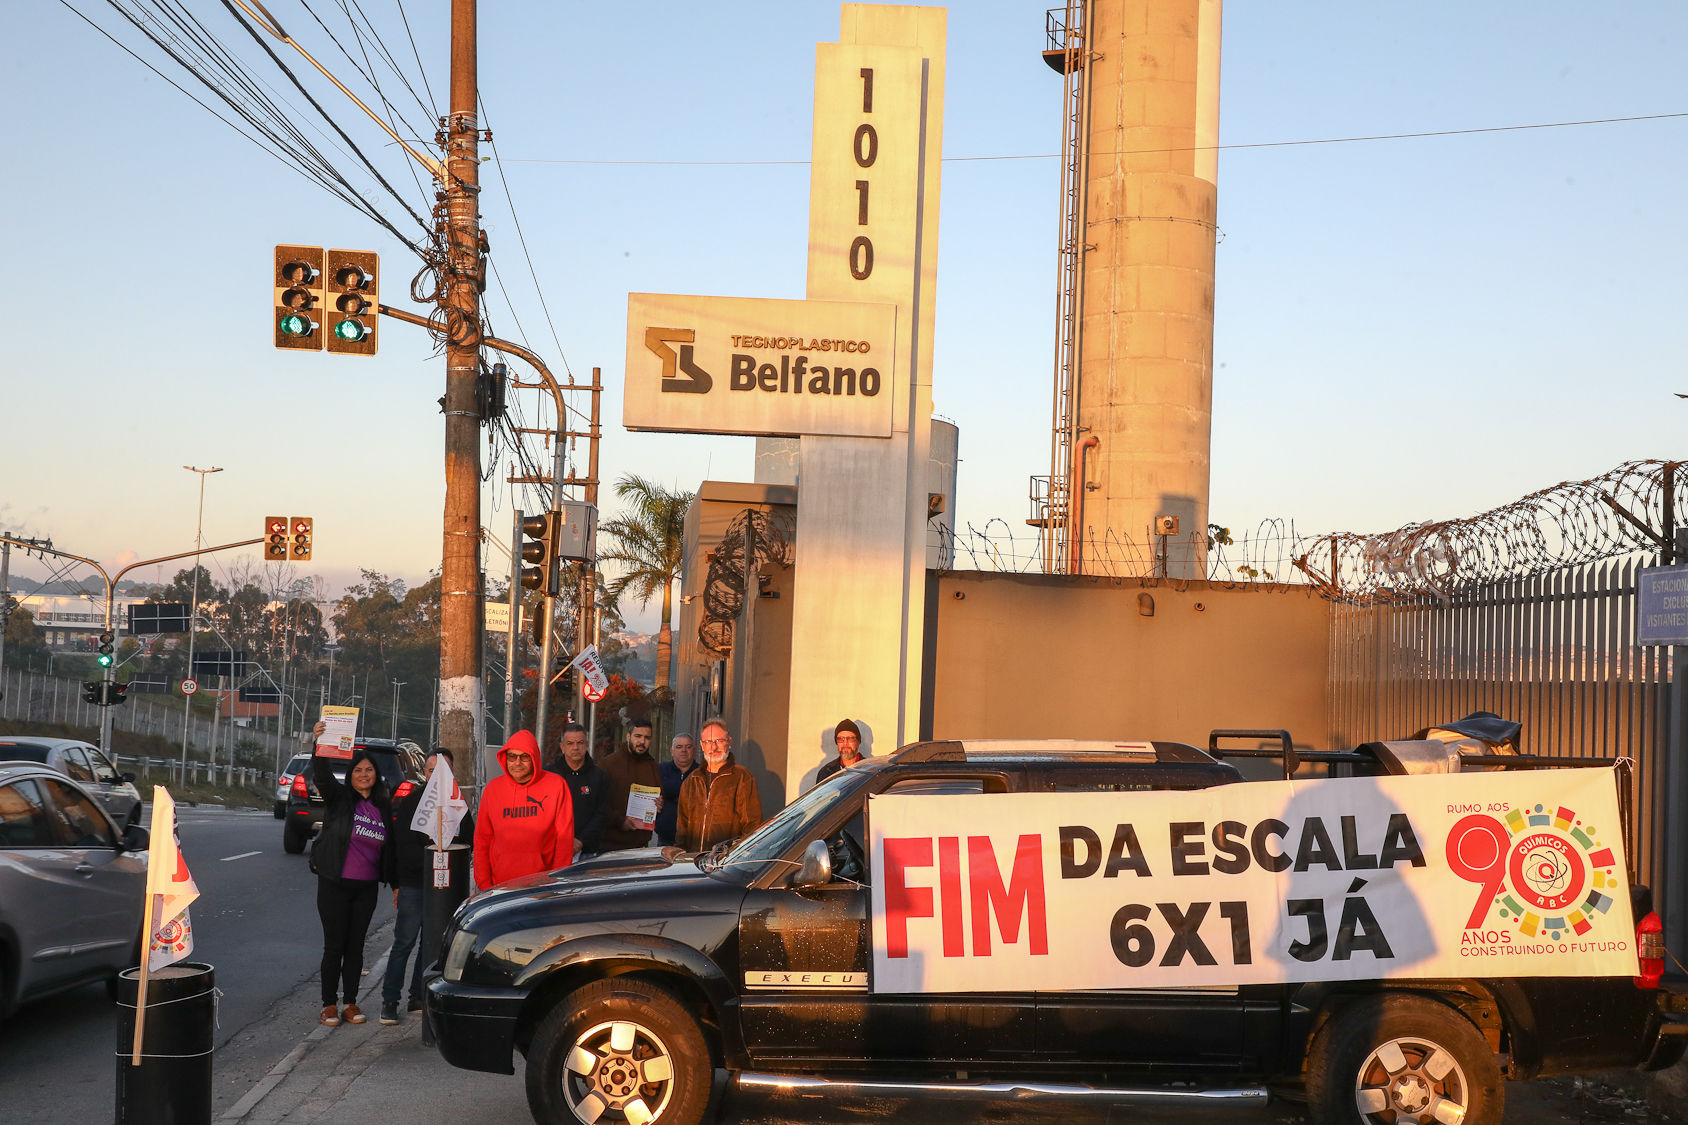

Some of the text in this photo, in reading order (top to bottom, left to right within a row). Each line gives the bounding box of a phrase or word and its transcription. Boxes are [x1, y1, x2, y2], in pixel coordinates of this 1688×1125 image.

[731, 334, 871, 354] TECNOPLASTICO
[730, 353, 881, 397] Belfano
[1663, 596, 1688, 609] EXCLUS
[1647, 613, 1686, 627] VISITANTES
[184, 682, 195, 690] 50
[503, 806, 538, 818] PUMA
[1447, 802, 1510, 814] RUMO AOS
[1058, 813, 1427, 879] DA ESCALA
[1519, 836, 1568, 855] QUÍMICOS
[883, 834, 1049, 959] FIM
[1287, 877, 1395, 962] JÁ
[1461, 930, 1511, 945] ANOS
[1460, 941, 1627, 957] CONSTRUINDO O FUTURO
